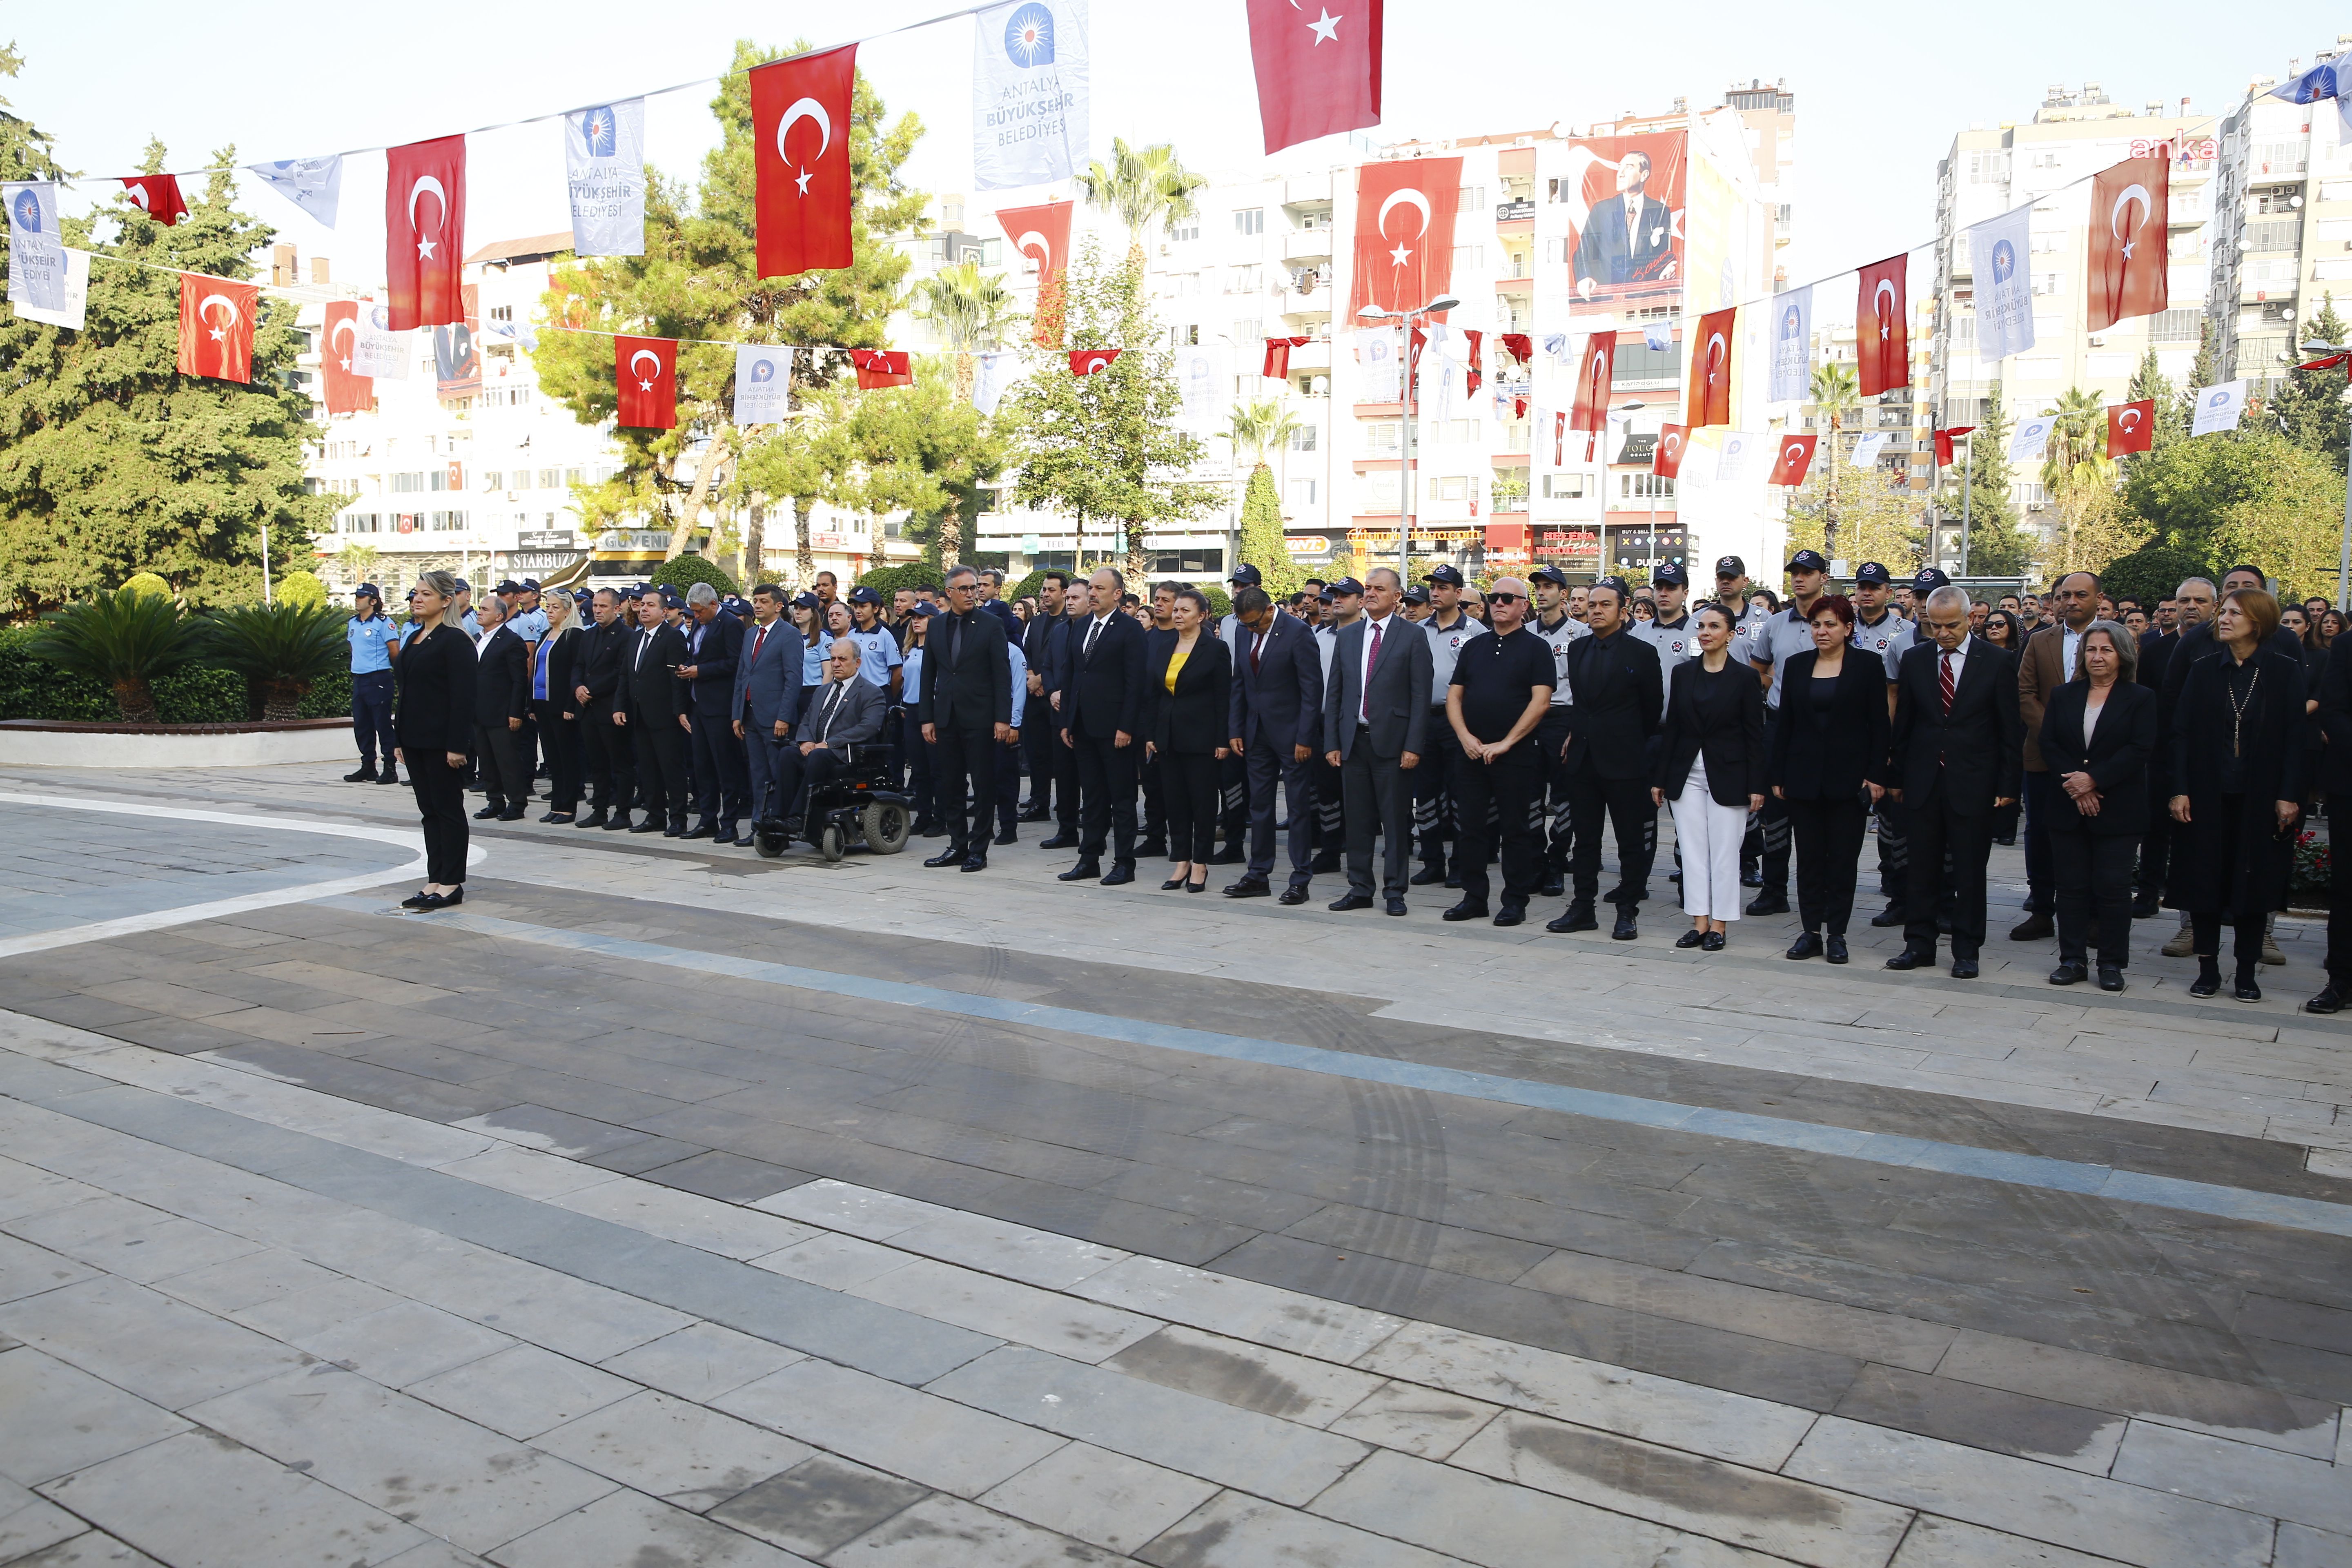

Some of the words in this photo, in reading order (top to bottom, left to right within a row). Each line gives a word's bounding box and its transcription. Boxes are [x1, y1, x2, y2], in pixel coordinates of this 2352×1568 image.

[1002, 76, 1060, 101] ANTALYA
[987, 90, 1074, 127] BÜYÜKŞEHİR
[998, 118, 1065, 146] BELEDİYES
[572, 166, 617, 180] ANTALYA
[570, 181, 631, 202] YÜKŞEHİR
[572, 201, 622, 217] ELEDİYESİ
[369, 334, 397, 343] ANTALYA
[360, 342, 404, 354] BÜYÜKŞEHİR
[365, 352, 399, 362] BELEDİYESİ
[1543, 532, 1596, 541] HELENA
[382, 538, 419, 548] SIEMENS
[1285, 539, 1321, 551] ONT.
[1483, 552, 1527, 560] SARGINLAR
[1536, 546, 1575, 555] WOOD
[513, 553, 578, 569] STARBUZZ
